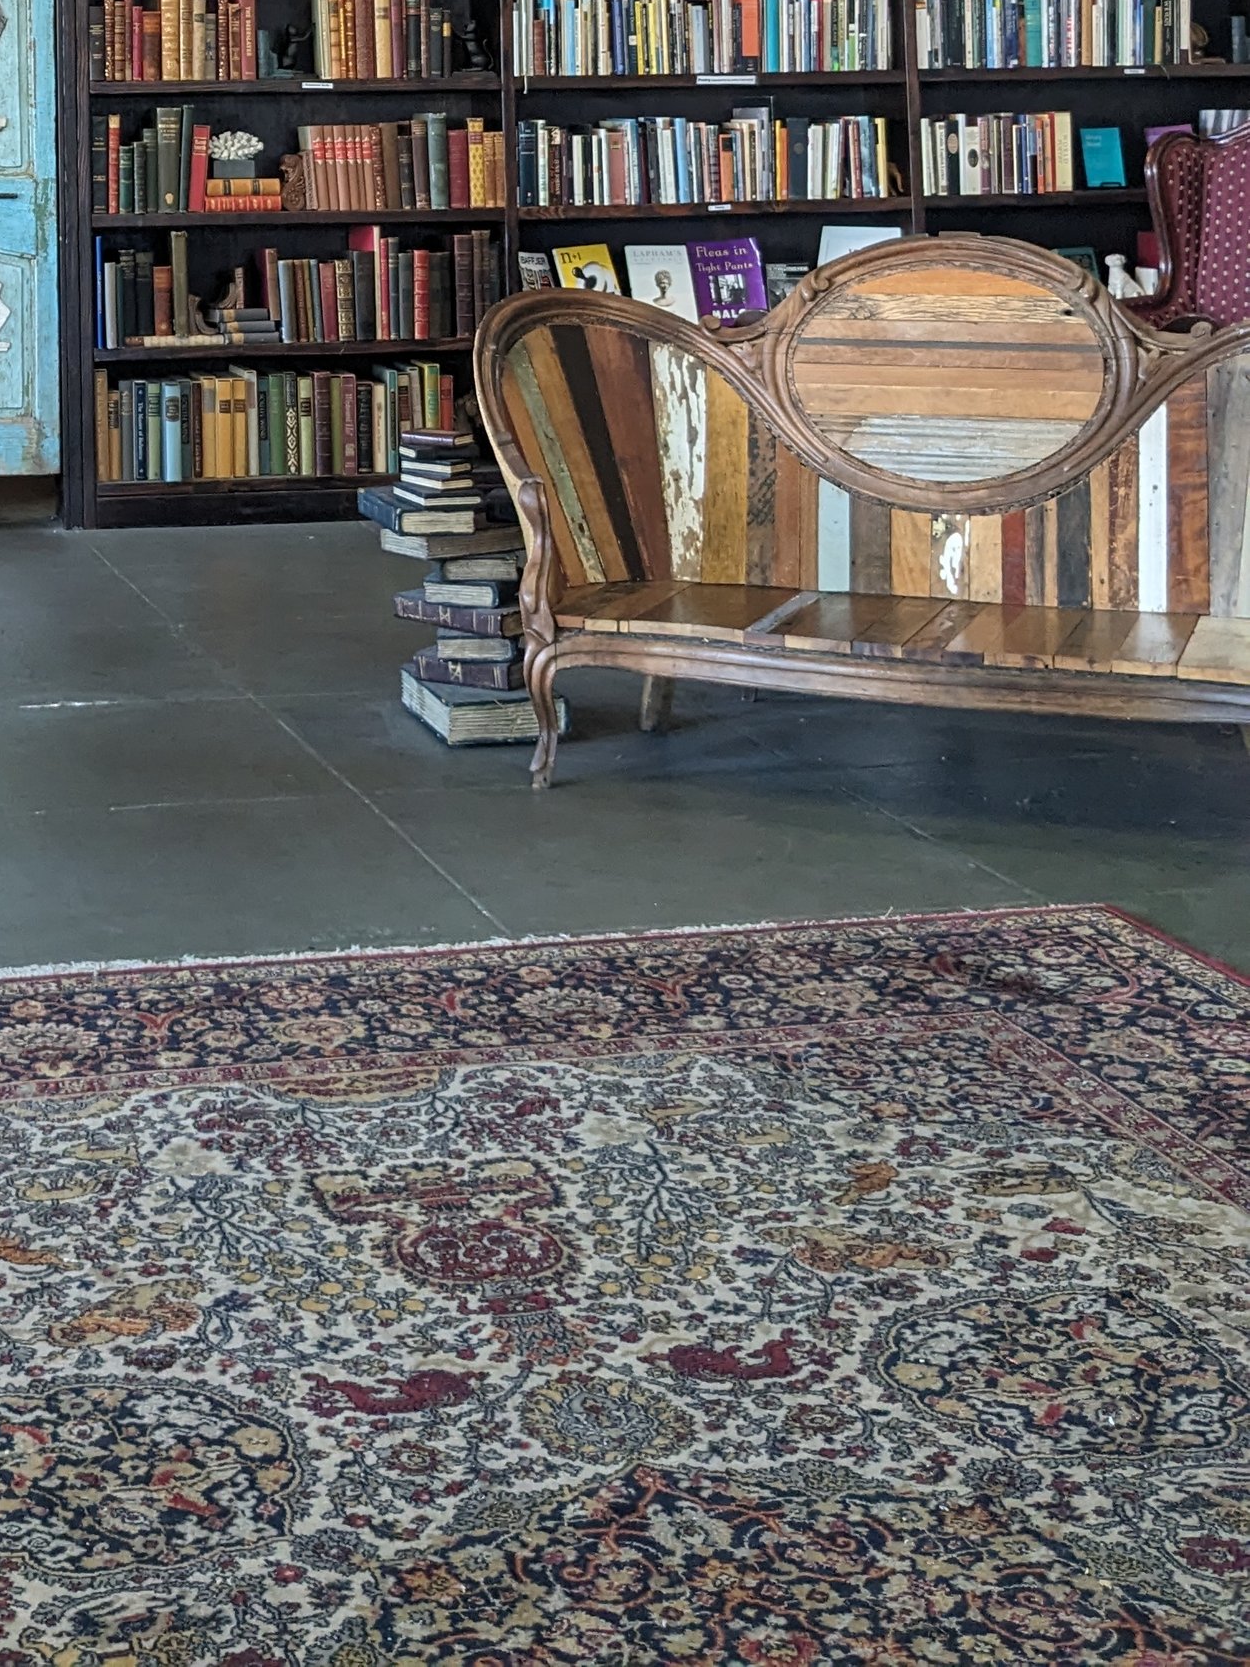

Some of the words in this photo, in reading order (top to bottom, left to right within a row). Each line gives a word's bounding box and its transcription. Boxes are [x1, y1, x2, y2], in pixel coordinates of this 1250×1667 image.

[633, 250, 682, 258] LAPHAM'S
[696, 246, 730, 258] Fleas
[734, 245, 748, 256] in
[560, 252, 582, 264] n+1
[696, 262, 722, 274] Tight
[724, 262, 754, 272] Pants
